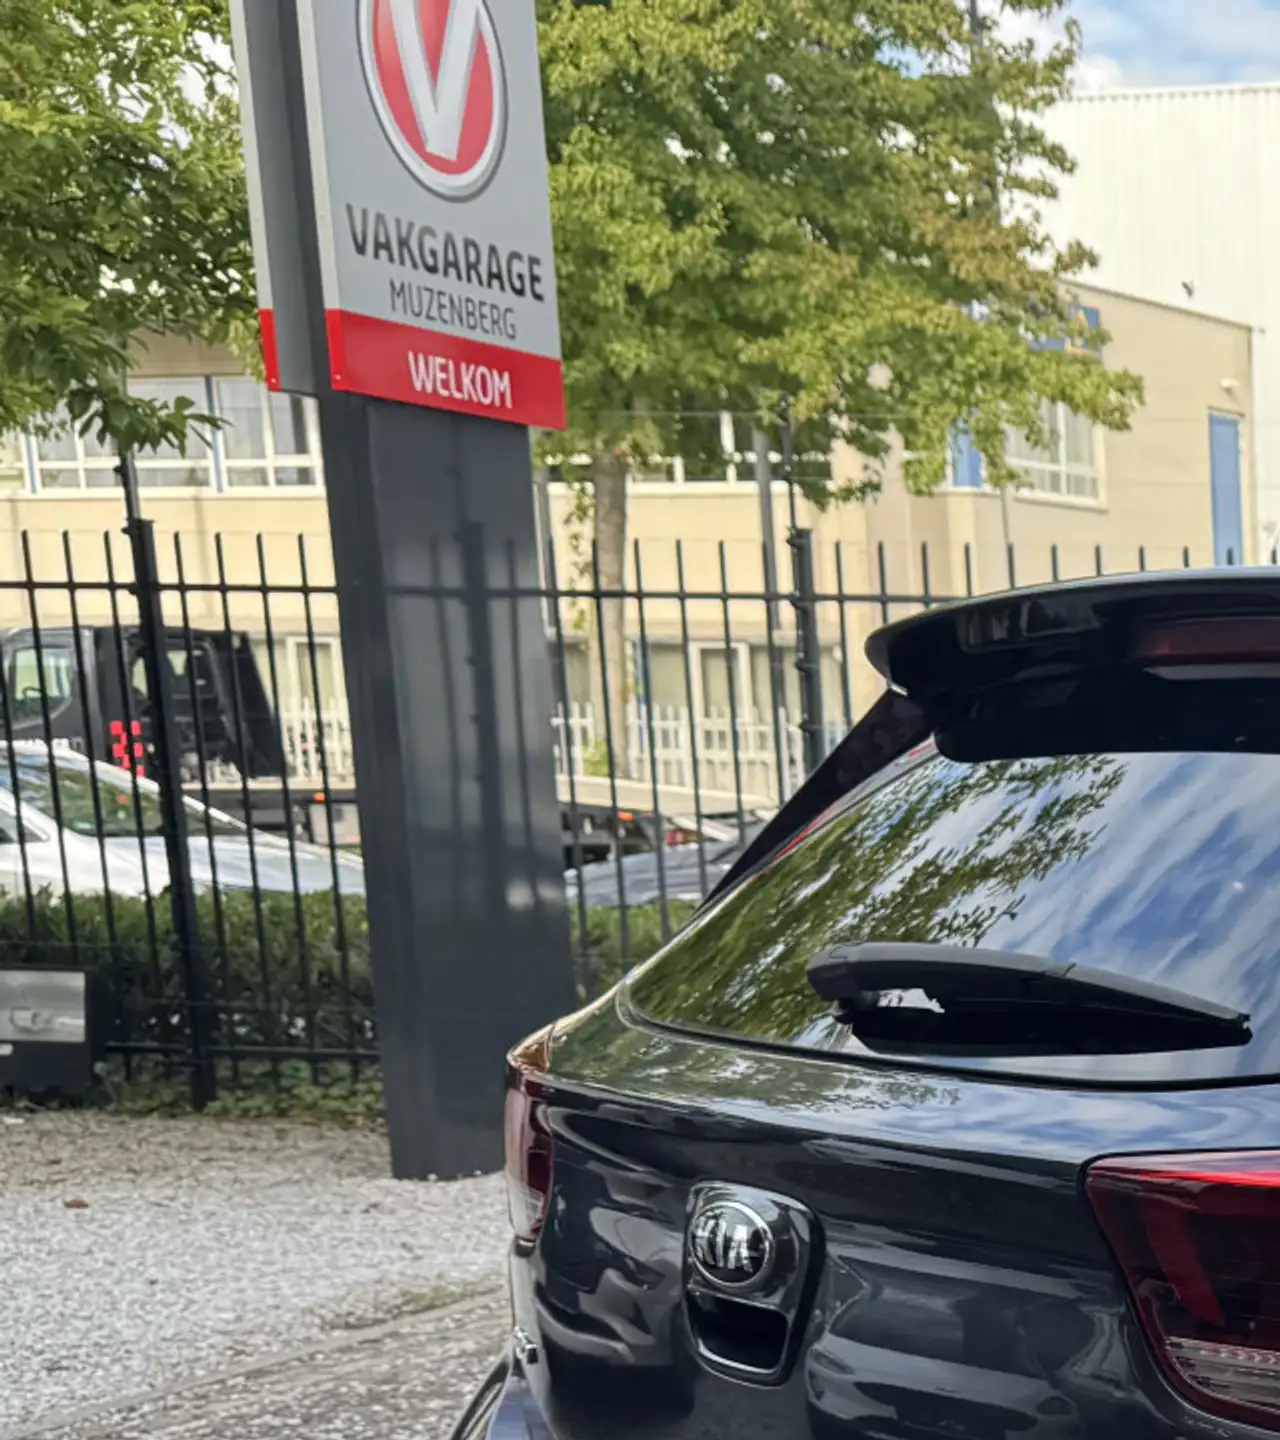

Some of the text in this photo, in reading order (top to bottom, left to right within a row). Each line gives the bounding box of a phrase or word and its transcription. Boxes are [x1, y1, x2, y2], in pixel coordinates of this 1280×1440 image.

[345, 203, 545, 302] VAKGARAGE
[389, 279, 517, 340] MUZENBERG
[407, 350, 513, 408] WELKOM
